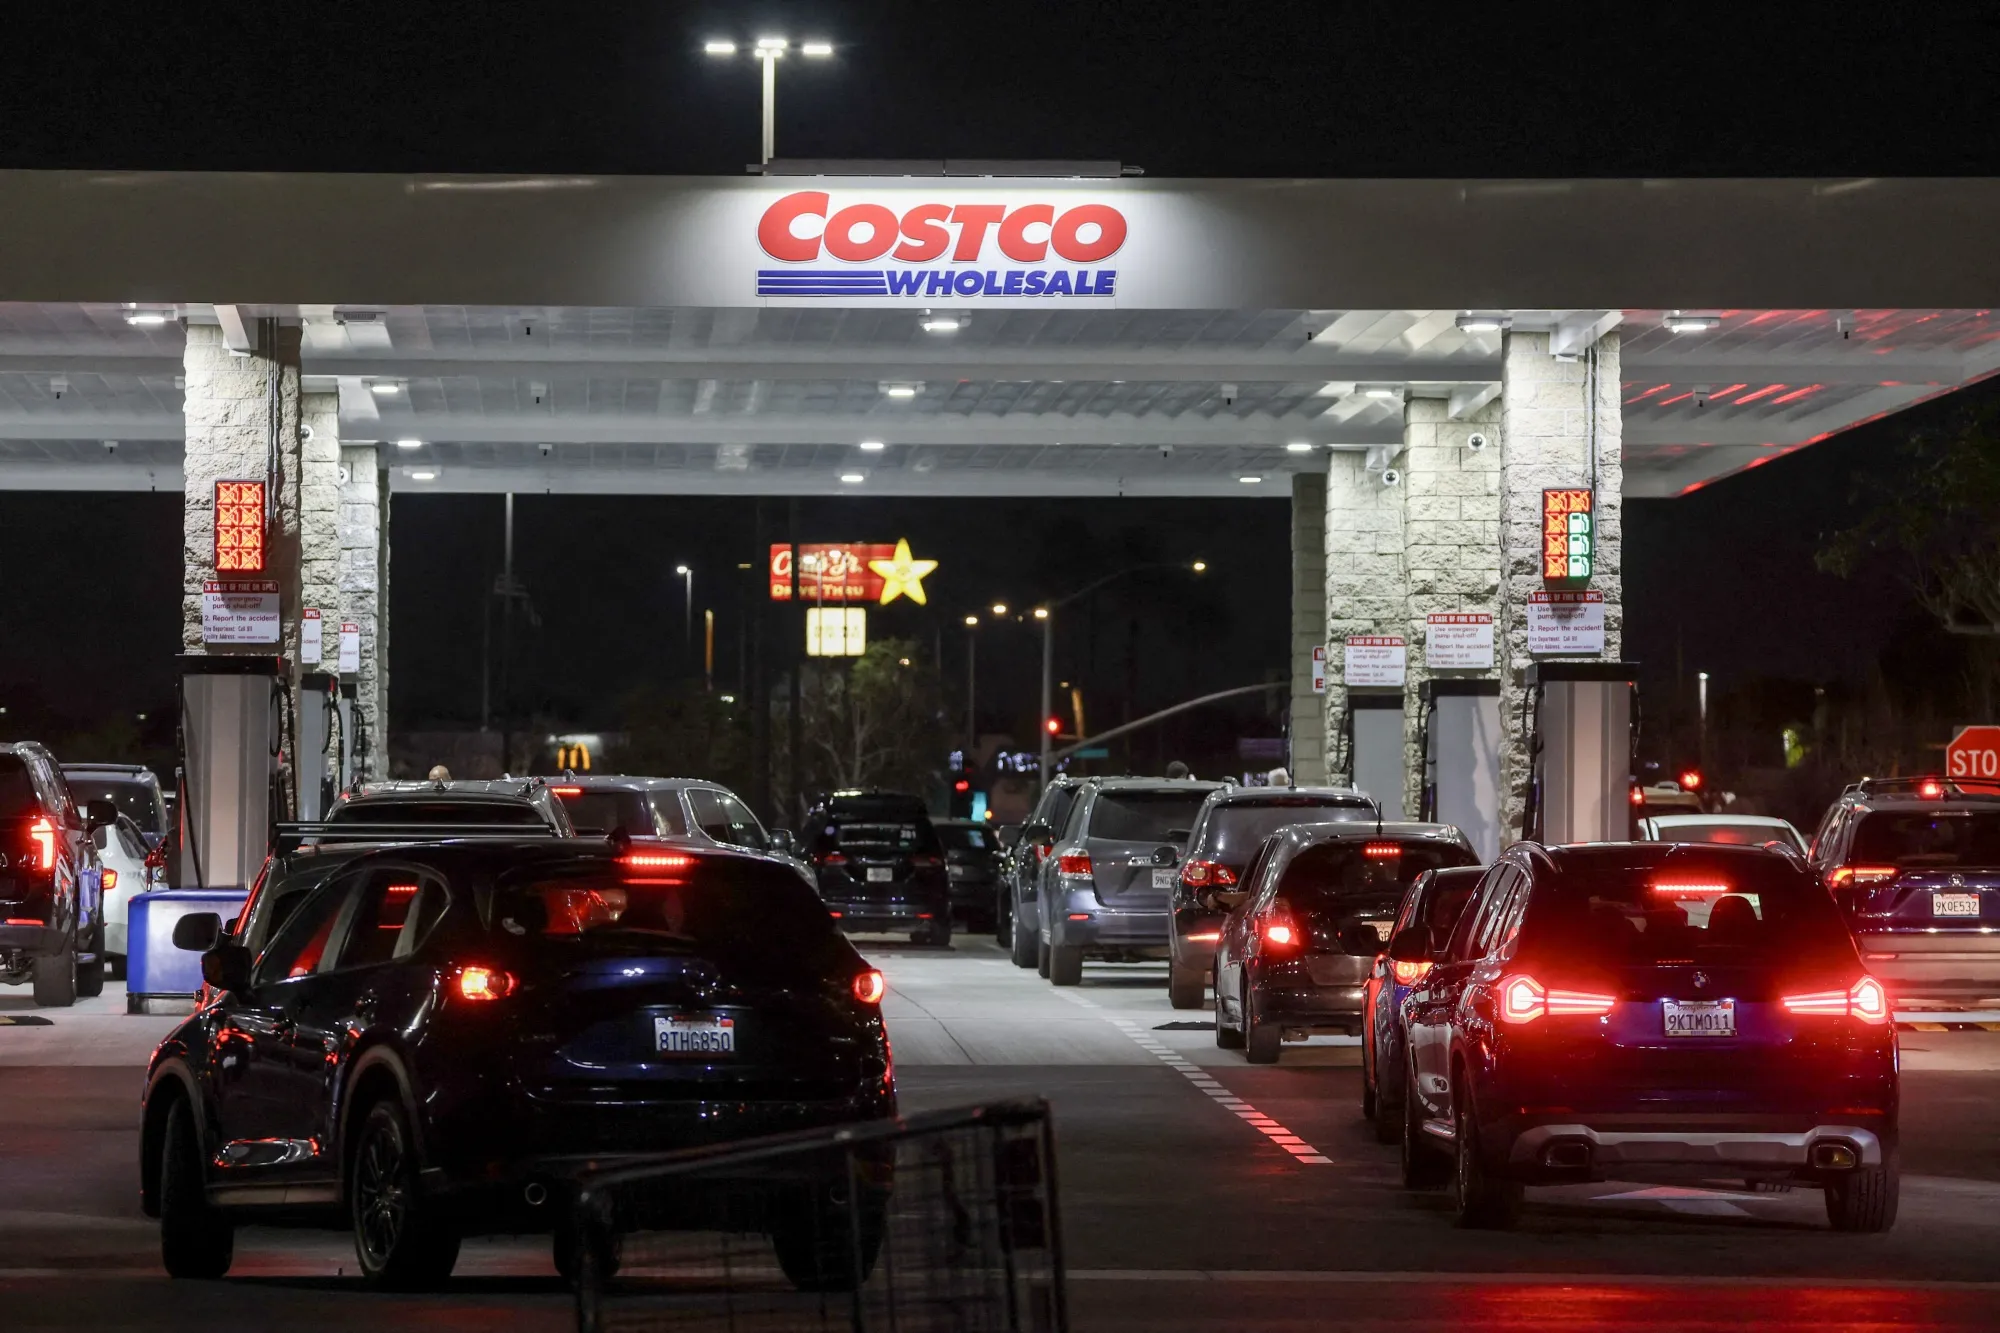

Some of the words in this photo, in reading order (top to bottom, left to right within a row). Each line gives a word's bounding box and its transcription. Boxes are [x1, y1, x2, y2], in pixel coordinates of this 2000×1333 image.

[757, 191, 1128, 263] COSTCO
[883, 270, 1115, 296] WHOLESALE
[1952, 750, 1998, 776] STO
[1936, 902, 1977, 912] 9KQE532
[1668, 1014, 1729, 1030] 9KIM011
[660, 1032, 730, 1050] 8THG850
